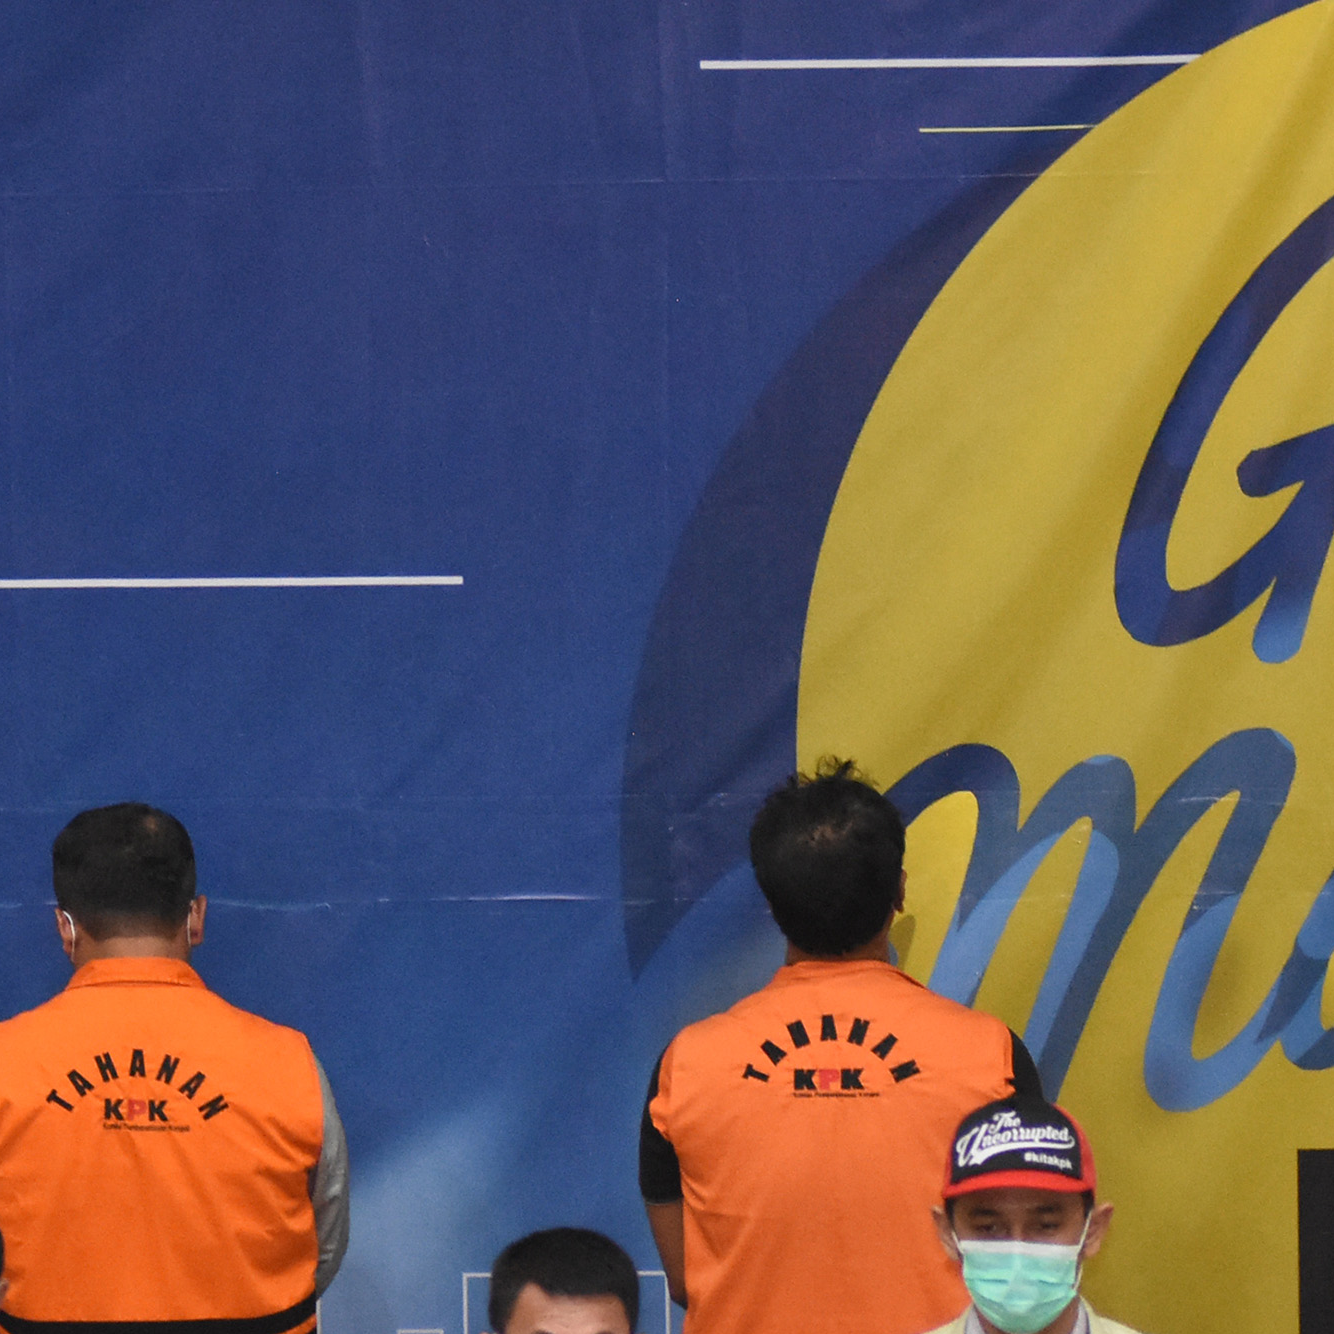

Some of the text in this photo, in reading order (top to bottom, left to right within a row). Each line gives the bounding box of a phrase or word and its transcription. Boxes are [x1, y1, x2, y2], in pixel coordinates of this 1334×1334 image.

[743, 1014, 921, 1083] TAHANAN
[46, 1049, 229, 1121] TAHANAN
[794, 1068, 865, 1090] KPK
[104, 1098, 168, 1122] KPK
[989, 1110, 1021, 1133] The
[955, 1122, 1076, 1167] Uncorrupted
